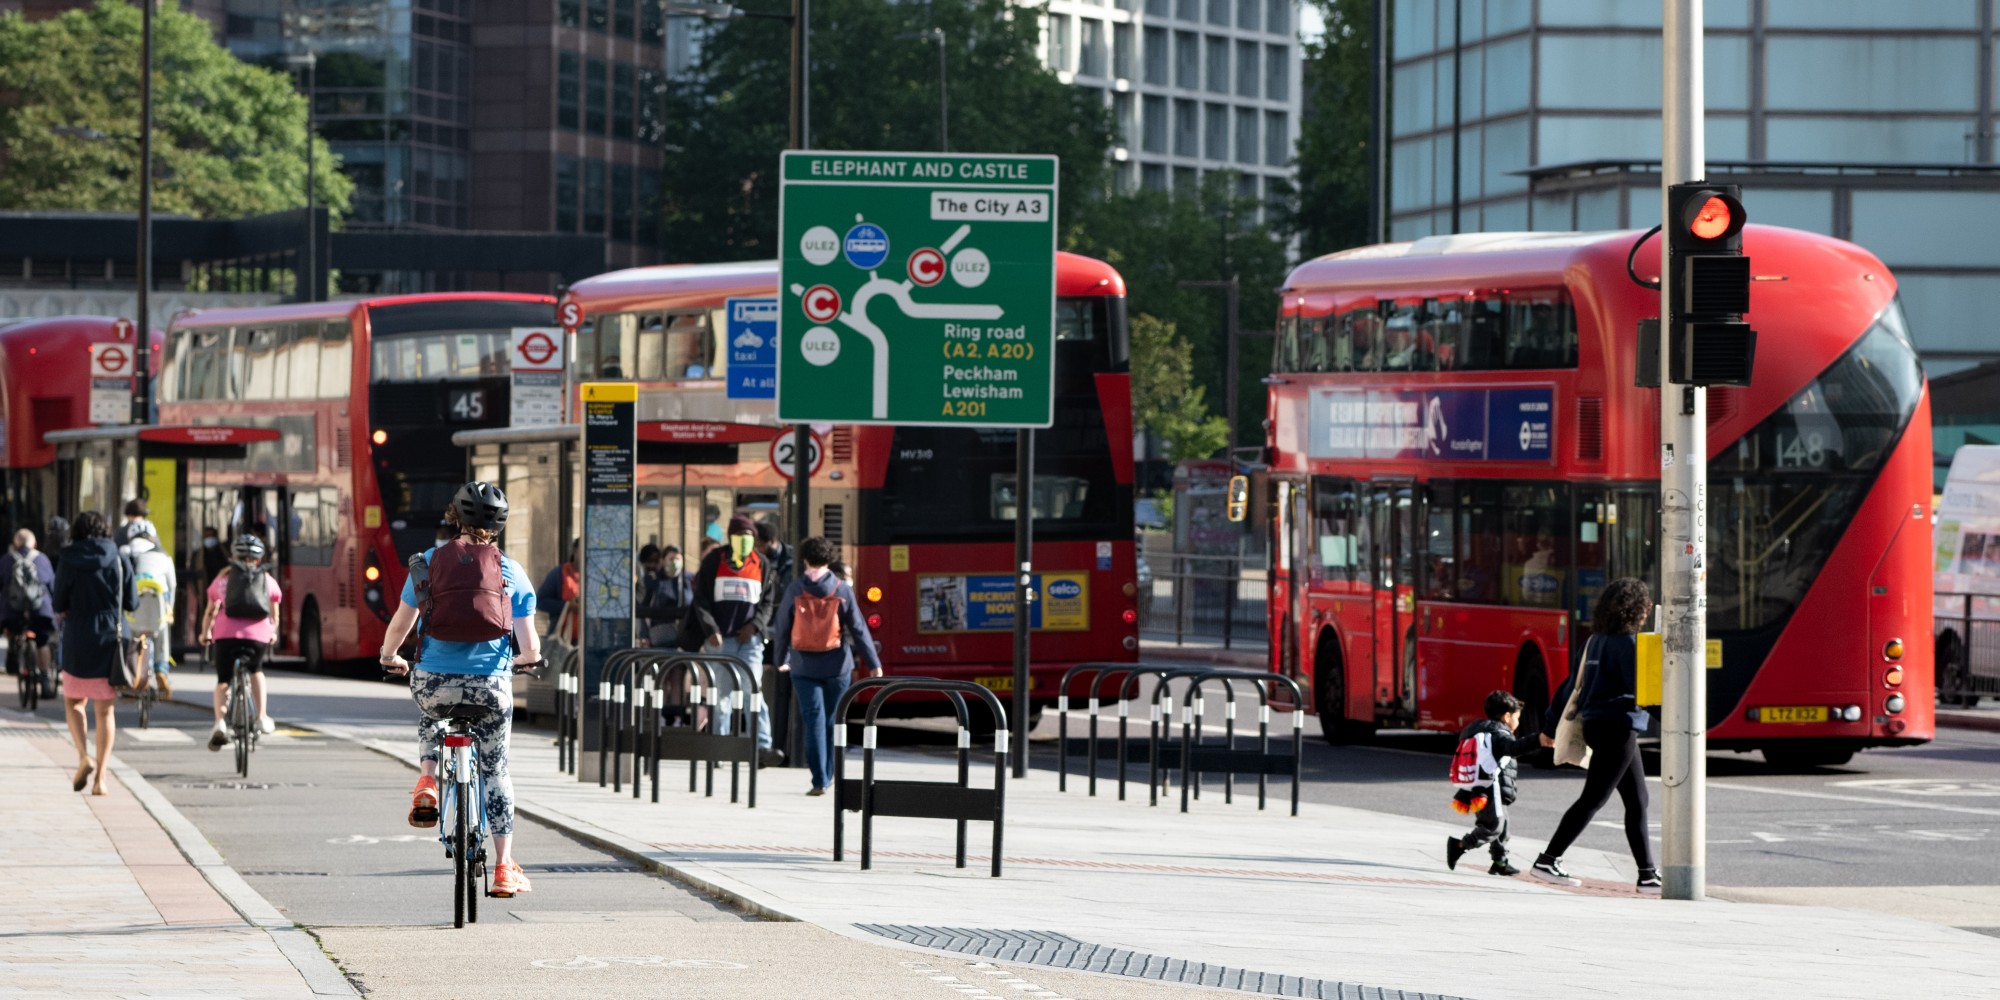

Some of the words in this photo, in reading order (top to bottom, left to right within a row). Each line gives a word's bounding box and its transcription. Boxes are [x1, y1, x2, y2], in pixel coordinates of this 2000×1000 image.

[811, 160, 907, 177] ELEPHANT
[912, 161, 954, 178] AND
[959, 163, 1028, 180] CASTLE
[937, 198, 968, 214] The
[974, 199, 1009, 216] City
[805, 241, 835, 251] ULEZ
[955, 262, 986, 273] ULEZ
[564, 304, 578, 325] S
[118, 322, 129, 339] T
[944, 323, 981, 341] Ring
[987, 325, 1025, 340] road
[805, 341, 836, 351] ULEZ
[735, 351, 756, 361] taxi
[943, 365, 1018, 380] Peckham
[742, 377, 755, 388] At
[943, 383, 1023, 399] Lewisham
[454, 393, 483, 418] 45
[661, 423, 690, 432] Elephant
[1776, 433, 1825, 467] 148
[969, 591, 1039, 602] RECRUITG
[1049, 585, 1080, 595] selco
[902, 645, 947, 653] VOLVO
[1769, 707, 1793, 720] LTZ
